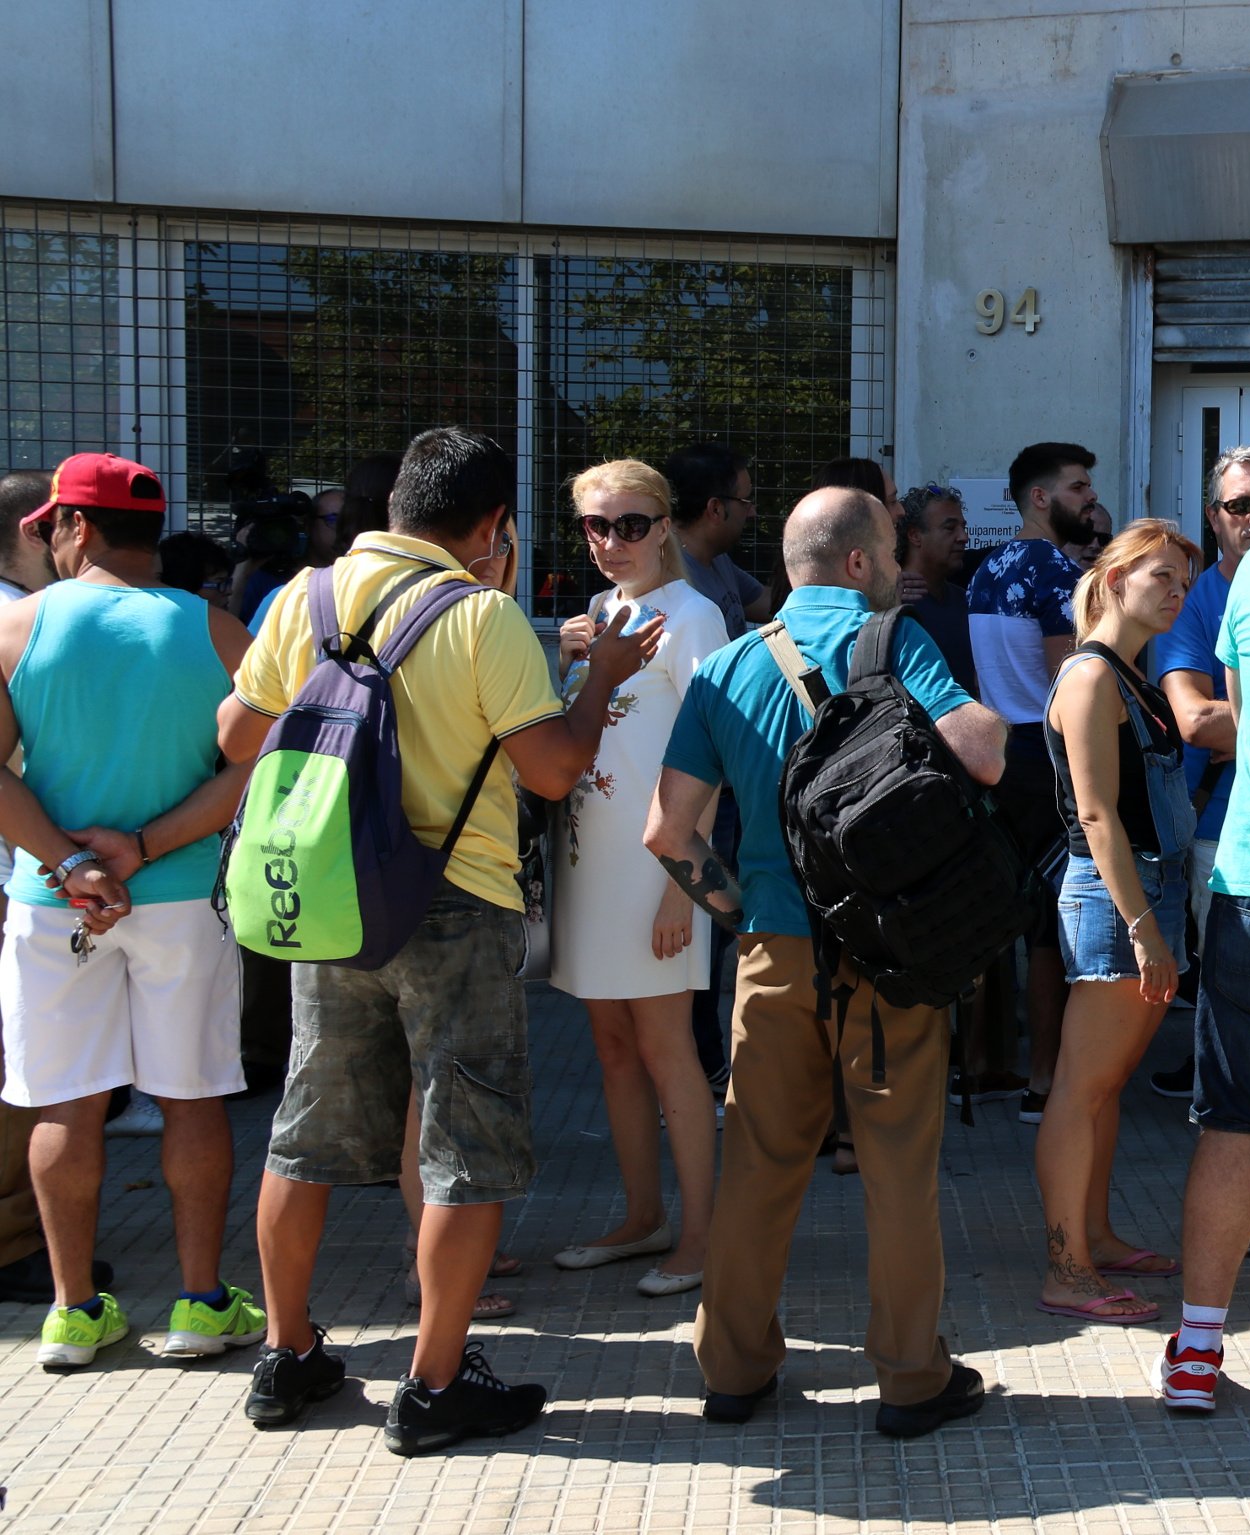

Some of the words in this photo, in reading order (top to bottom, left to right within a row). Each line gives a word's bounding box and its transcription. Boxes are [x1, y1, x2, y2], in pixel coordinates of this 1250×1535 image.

[976, 287, 1040, 334] 94
[974, 538, 992, 549] Prat
[261, 769, 320, 948] Reebok
